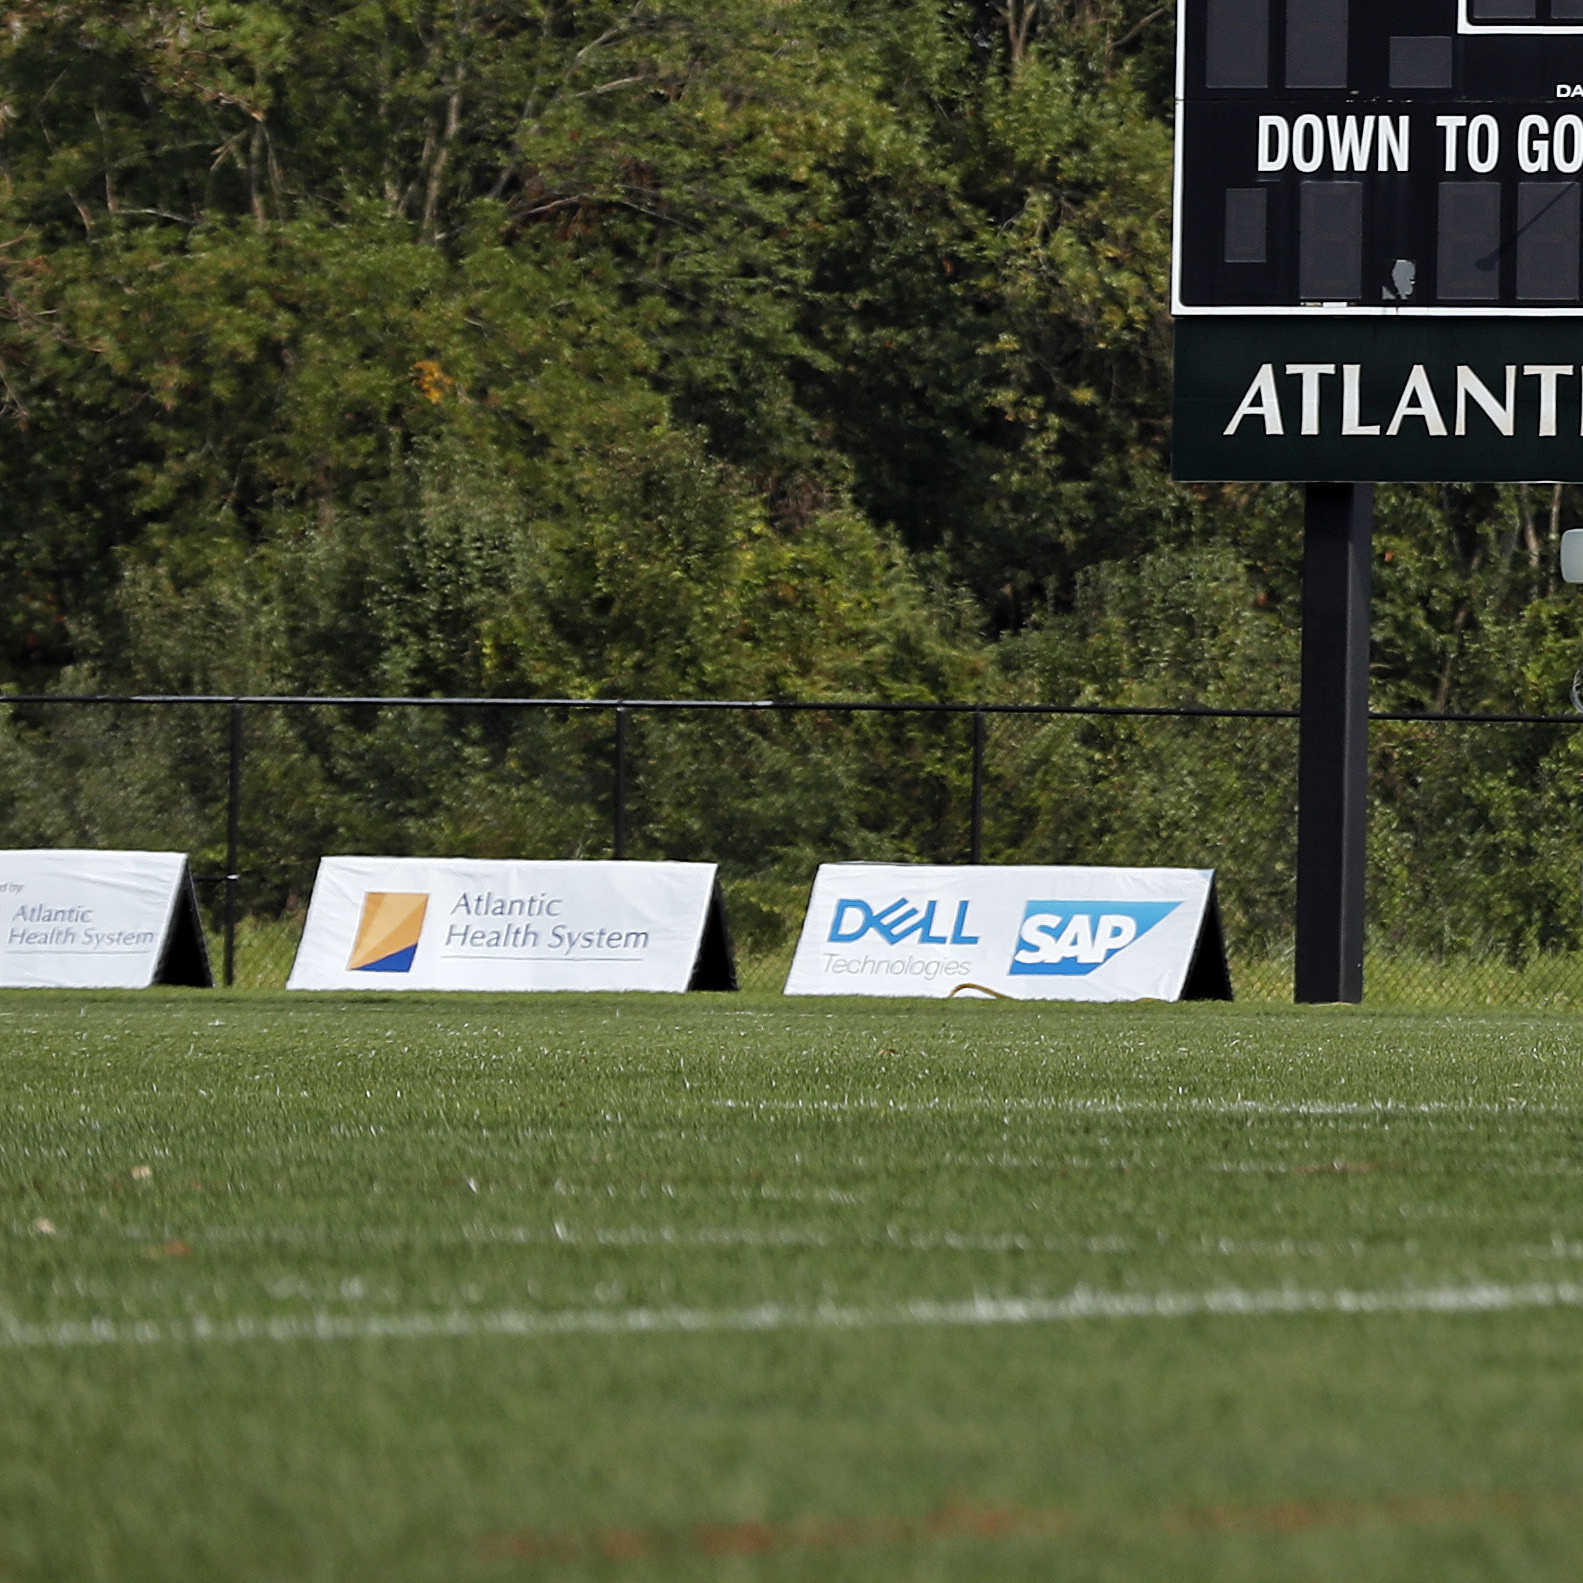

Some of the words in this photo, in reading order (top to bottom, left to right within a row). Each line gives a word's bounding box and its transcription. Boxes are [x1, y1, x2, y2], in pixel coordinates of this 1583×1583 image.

[1257, 114, 1410, 173] DOWN
[1436, 114, 1499, 173] TO
[12, 903, 93, 923] Atlantic
[450, 892, 563, 916] Atlantic
[826, 897, 980, 945] DELL
[8, 926, 75, 945] Health
[81, 927, 154, 950] System
[445, 923, 539, 948] Health
[547, 925, 649, 955] System
[1014, 913, 1137, 964] SAP
[822, 953, 971, 980] Technologies
